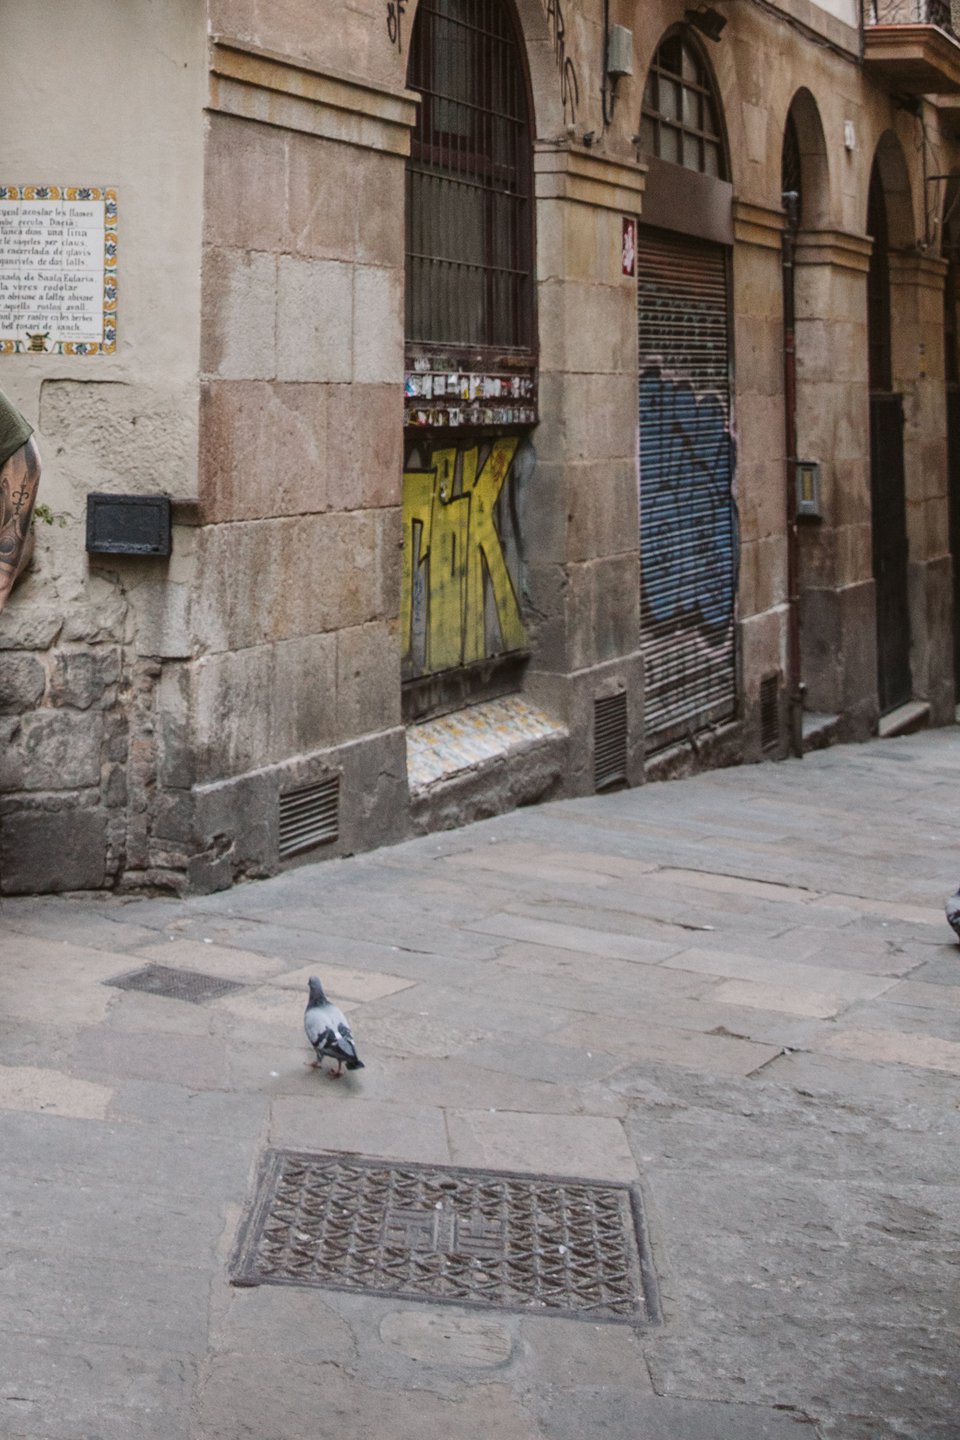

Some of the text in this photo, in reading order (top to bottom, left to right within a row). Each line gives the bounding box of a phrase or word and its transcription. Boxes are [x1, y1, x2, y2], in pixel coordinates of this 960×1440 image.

[56, 208, 67, 216] les
[53, 247, 63, 255] de
[37, 257, 48, 265] de
[24, 272, 34, 281] de
[37, 272, 62, 282] Santa
[0, 282, 9, 291] la
[43, 322, 53, 330] de
